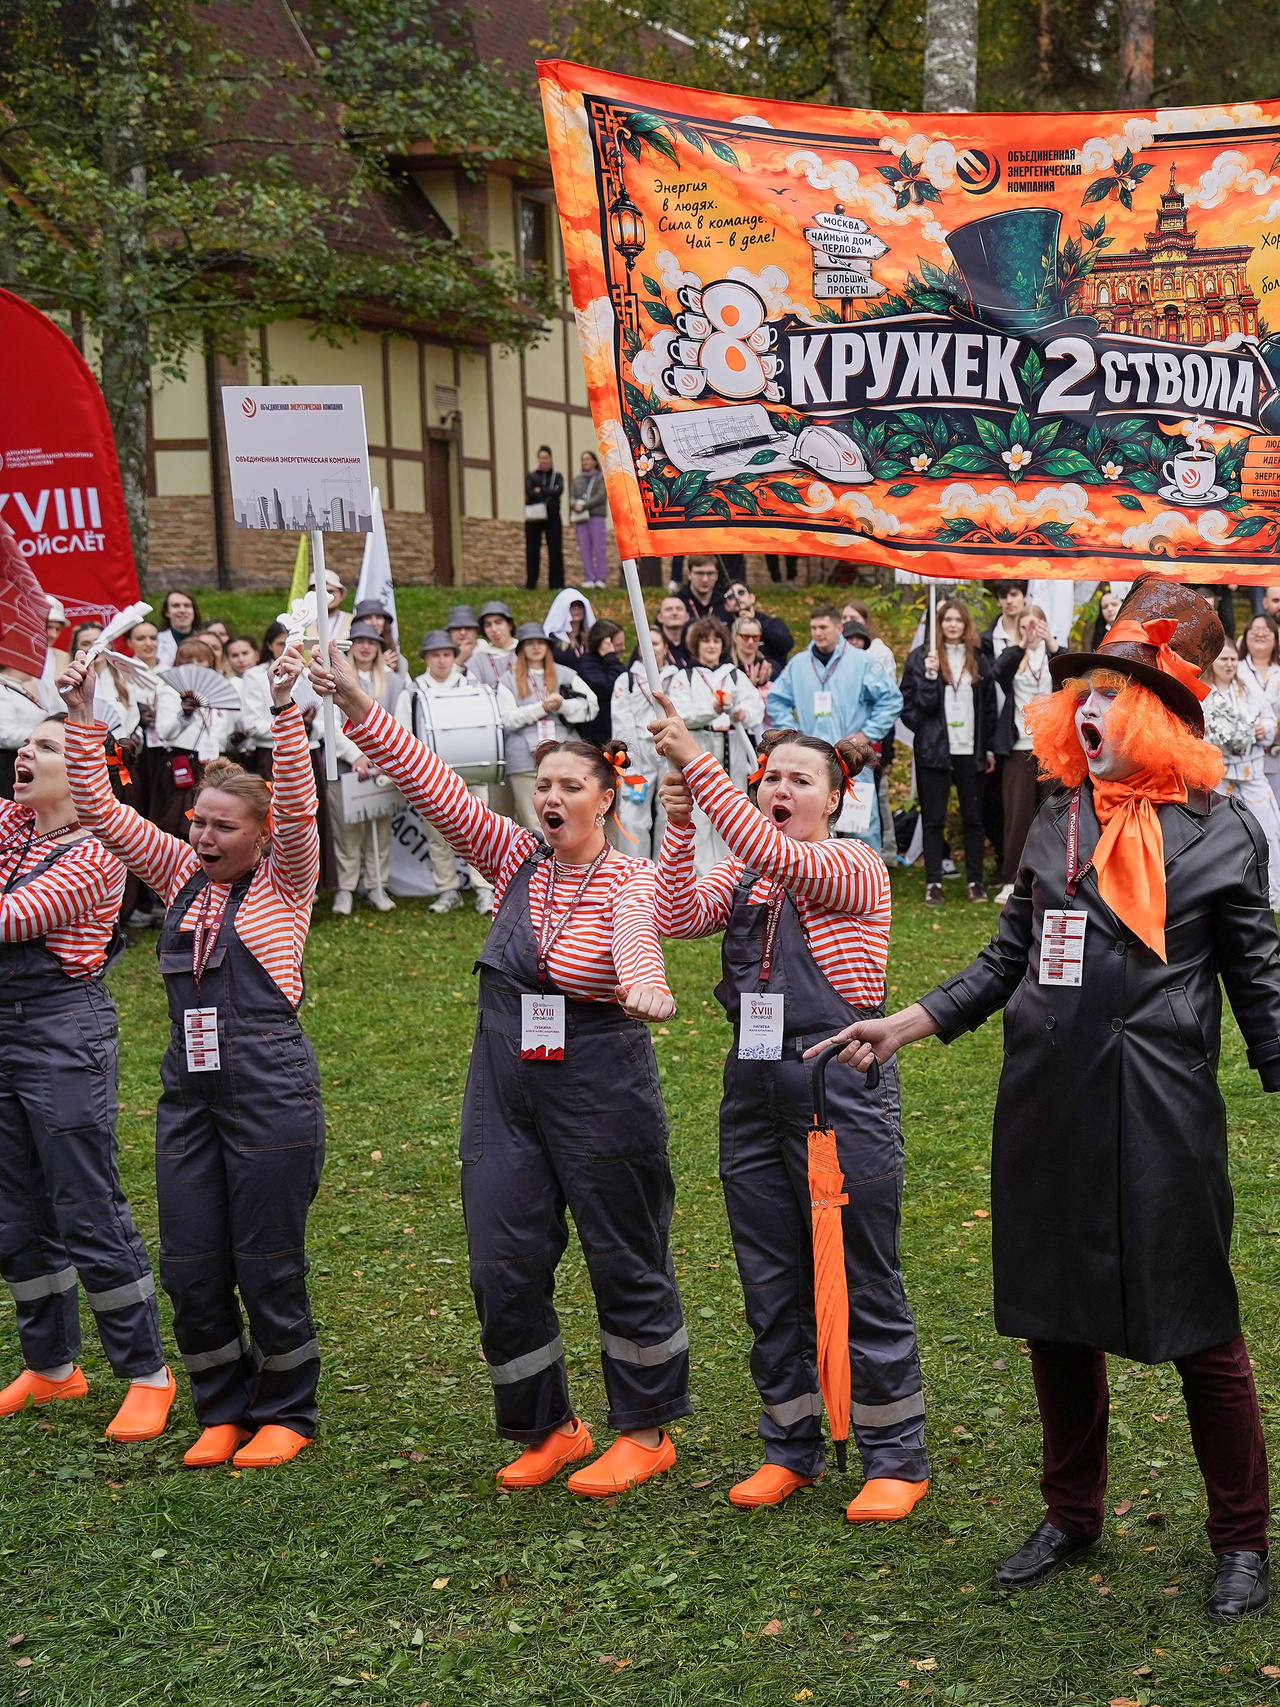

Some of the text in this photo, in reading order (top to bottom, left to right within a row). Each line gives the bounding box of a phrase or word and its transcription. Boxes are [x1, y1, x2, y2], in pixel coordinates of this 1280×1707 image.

[1008, 150, 1075, 163] ОБЪЕДИНЕННАЯ
[1008, 165, 1082, 178] ЭНЕРГЕТИЧЕСКАЯ
[654, 179, 707, 198] Энергия
[1008, 181, 1055, 193] КОМПАНИЯ
[663, 198, 718, 217] в людях.
[659, 214, 768, 232] Сила в команде.
[824, 216, 860, 230] МОСКВА
[686, 234, 711, 249] Чай
[729, 233, 736, 247] в
[741, 228, 776, 251] деле!
[811, 231, 872, 246] ЧАЙНЫЙ ДОМ
[822, 243, 863, 254] ПЕРЛОВА
[827, 274, 868, 284] БОЛЬШИЕ
[827, 285, 869, 294] ПРОЕКТЫ
[789, 331, 1023, 406] КРУЖЕК
[1037, 337, 1098, 414] 2
[1101, 350, 1255, 417] СТВОЛА
[235, 456, 279, 464] ОБЪЕДИНЕННАЯ
[280, 456, 328, 464] ЭНЕРГЕТИЧЕСКАЯ
[18, 530, 105, 558] ОЙСЛЁТ
[1069, 812, 1077, 834] ГОРОДА
[47, 826, 70, 838] ГОРОДА
[1067, 835, 1076, 868] ФУНДАМЕНТ
[766, 921, 776, 953] ФУНДАМЕНТ
[772, 900, 782, 921] ГОРОДА
[532, 1008, 554, 1016] XVIII
[751, 1006, 772, 1015] XVIII
